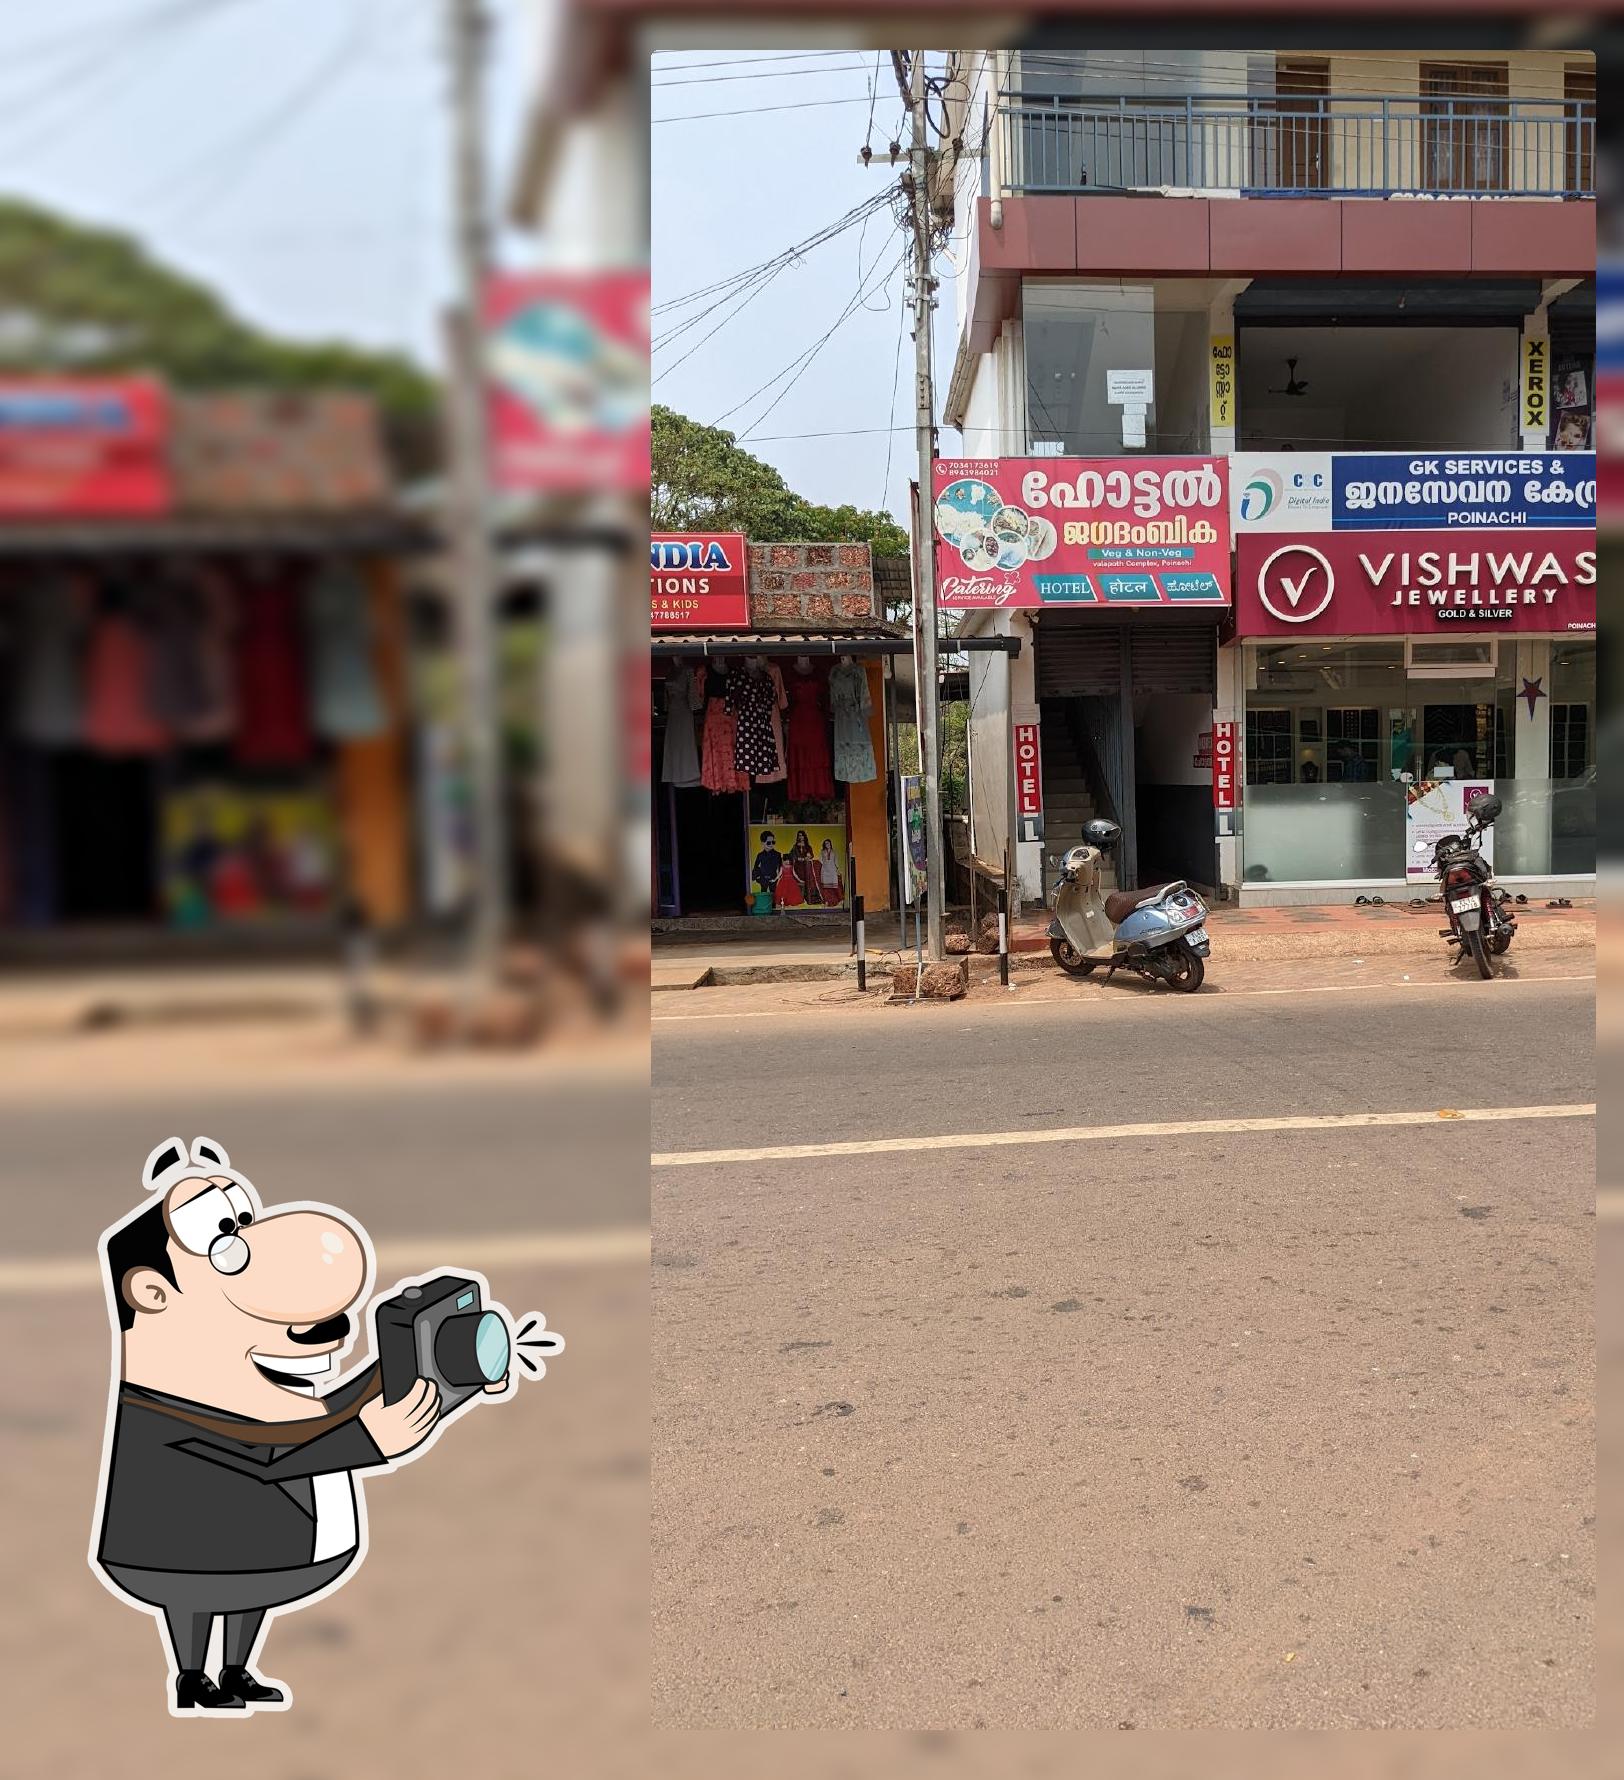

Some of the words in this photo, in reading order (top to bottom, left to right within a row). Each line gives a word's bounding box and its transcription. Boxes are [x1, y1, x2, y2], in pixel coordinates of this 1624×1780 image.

[1527, 341, 1544, 426] XEROX
[1409, 460, 1439, 475] GK
[1445, 459, 1544, 475] SERVICES
[1549, 459, 1565, 475] &
[1447, 511, 1527, 524] POINACHI
[1063, 514, 1217, 545] ജഗദംബിക
[1102, 549, 1122, 558] Veg
[1125, 549, 1133, 557] &
[1136, 548, 1182, 558] Non-Veg
[1126, 560, 1160, 568] Complex,
[1358, 551, 1597, 586] VISHWAS
[940, 575, 1017, 606] Catering
[1040, 582, 1091, 594] HOTEL
[1108, 578, 1149, 595] होटल
[661, 600, 669, 609] &
[673, 600, 699, 609] KIDS
[1391, 588, 1557, 605] JEWELLERY
[1438, 609, 1466, 618] GOLD
[1469, 609, 1476, 617] &
[1478, 608, 1513, 618] SILVER
[1020, 727, 1036, 811] HOTEL
[1216, 723, 1231, 806] HOTEL
